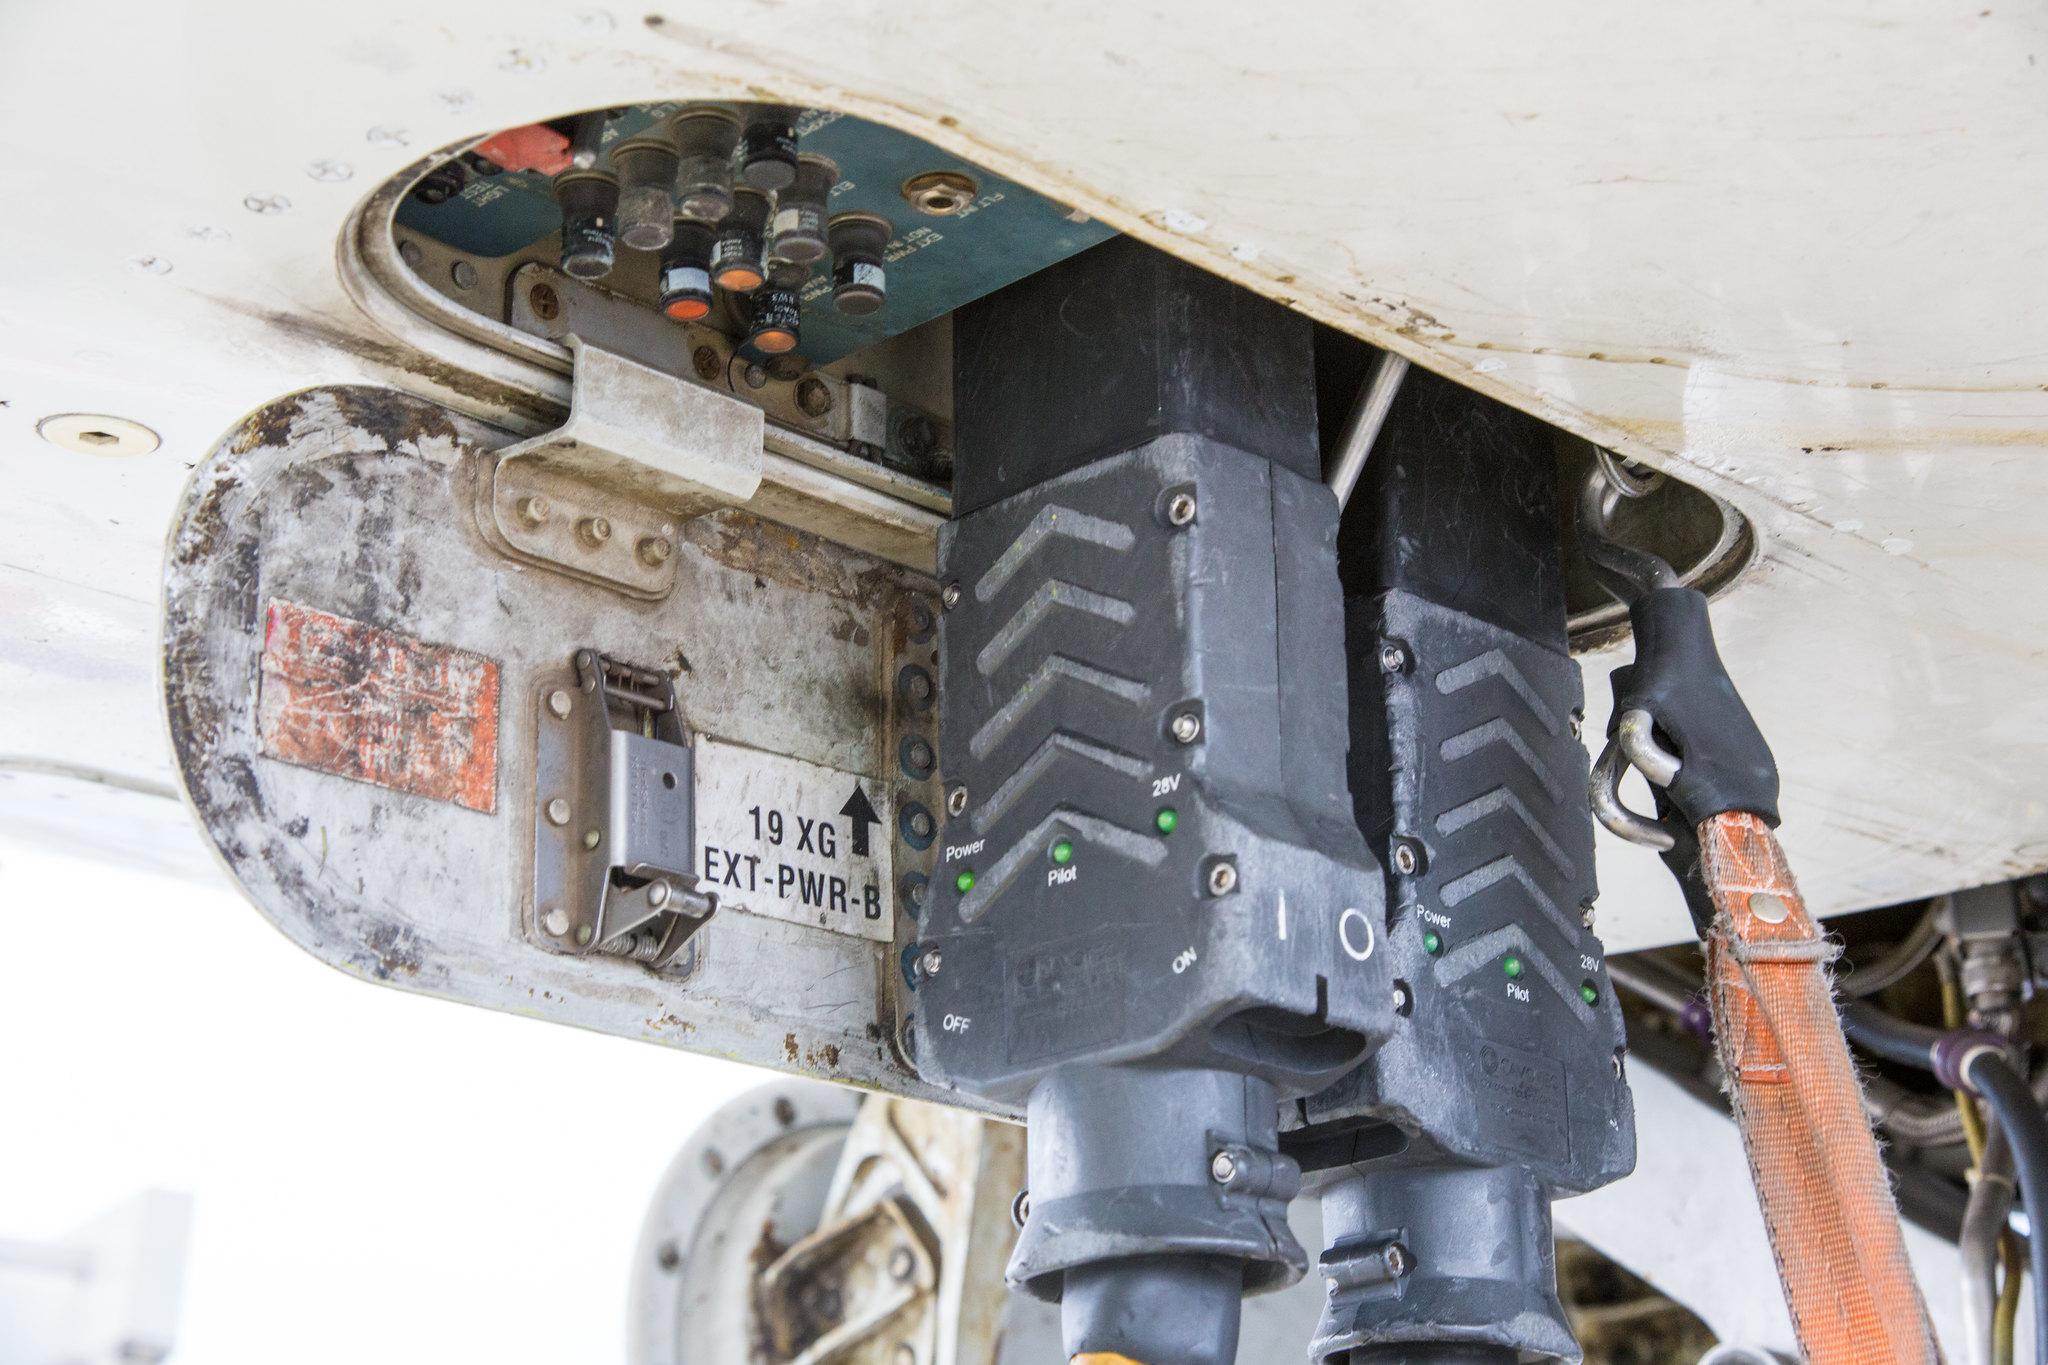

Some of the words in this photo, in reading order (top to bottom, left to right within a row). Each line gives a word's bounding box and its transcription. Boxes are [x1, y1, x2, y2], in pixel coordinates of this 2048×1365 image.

[1152, 773, 1181, 798] 28V
[749, 805, 783, 845] 19
[796, 816, 836, 859] XG
[945, 838, 985, 862] Power
[704, 846, 882, 920] EXT-PWR-B
[1047, 865, 1077, 887] Pilot
[1416, 904, 1452, 929] Power
[1172, 946, 1197, 974] ON
[1580, 954, 1601, 972] 28V
[1506, 983, 1530, 1002] Pilot
[943, 1013, 971, 1034] OFF
